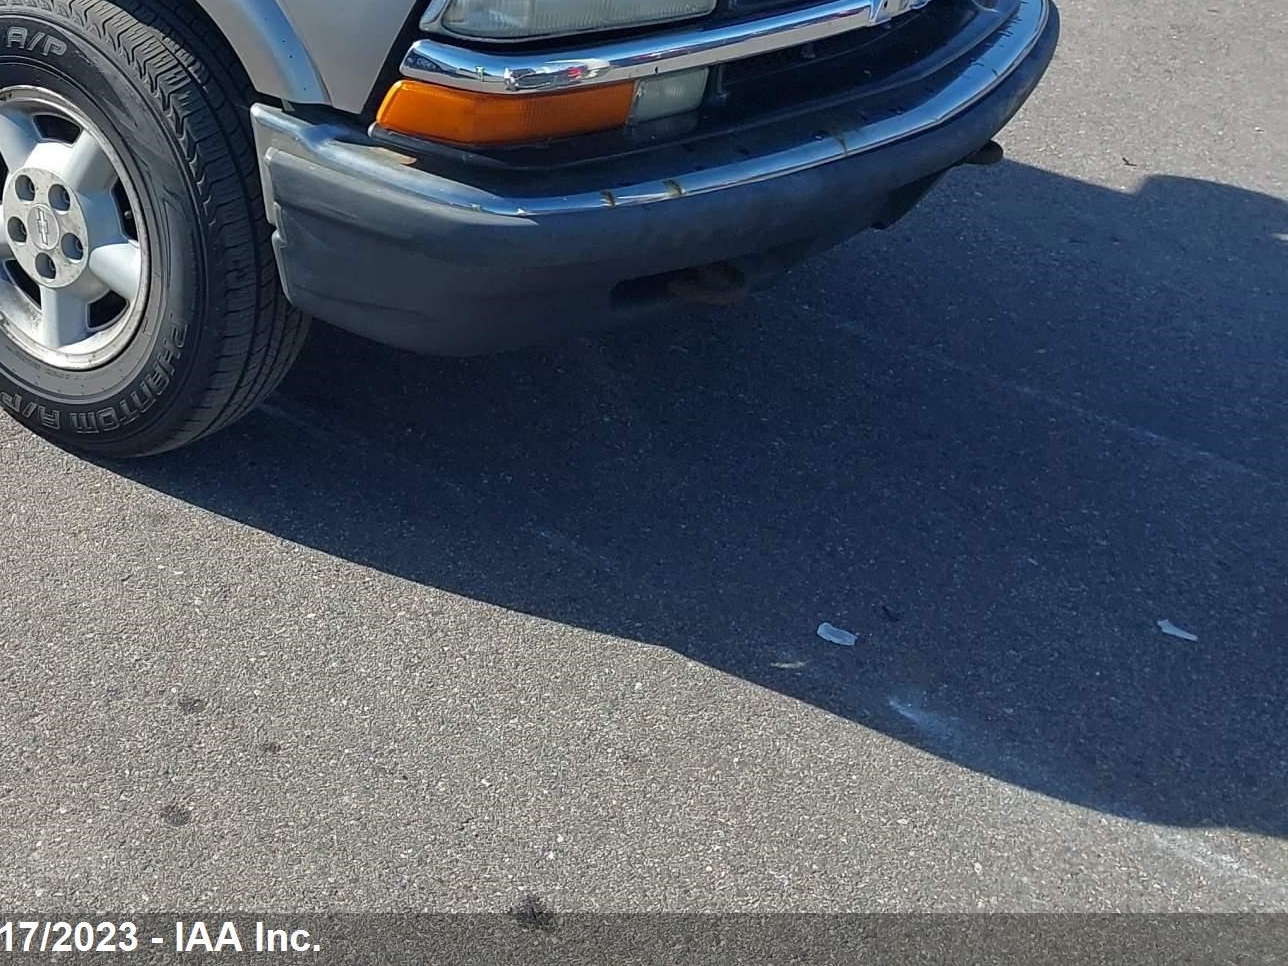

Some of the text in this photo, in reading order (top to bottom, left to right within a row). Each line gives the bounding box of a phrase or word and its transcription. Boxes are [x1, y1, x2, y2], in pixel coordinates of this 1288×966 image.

[6, 26, 68, 57] A/P
[69, 317, 188, 434] PHANTOM
[0, 391, 62, 431] A/P
